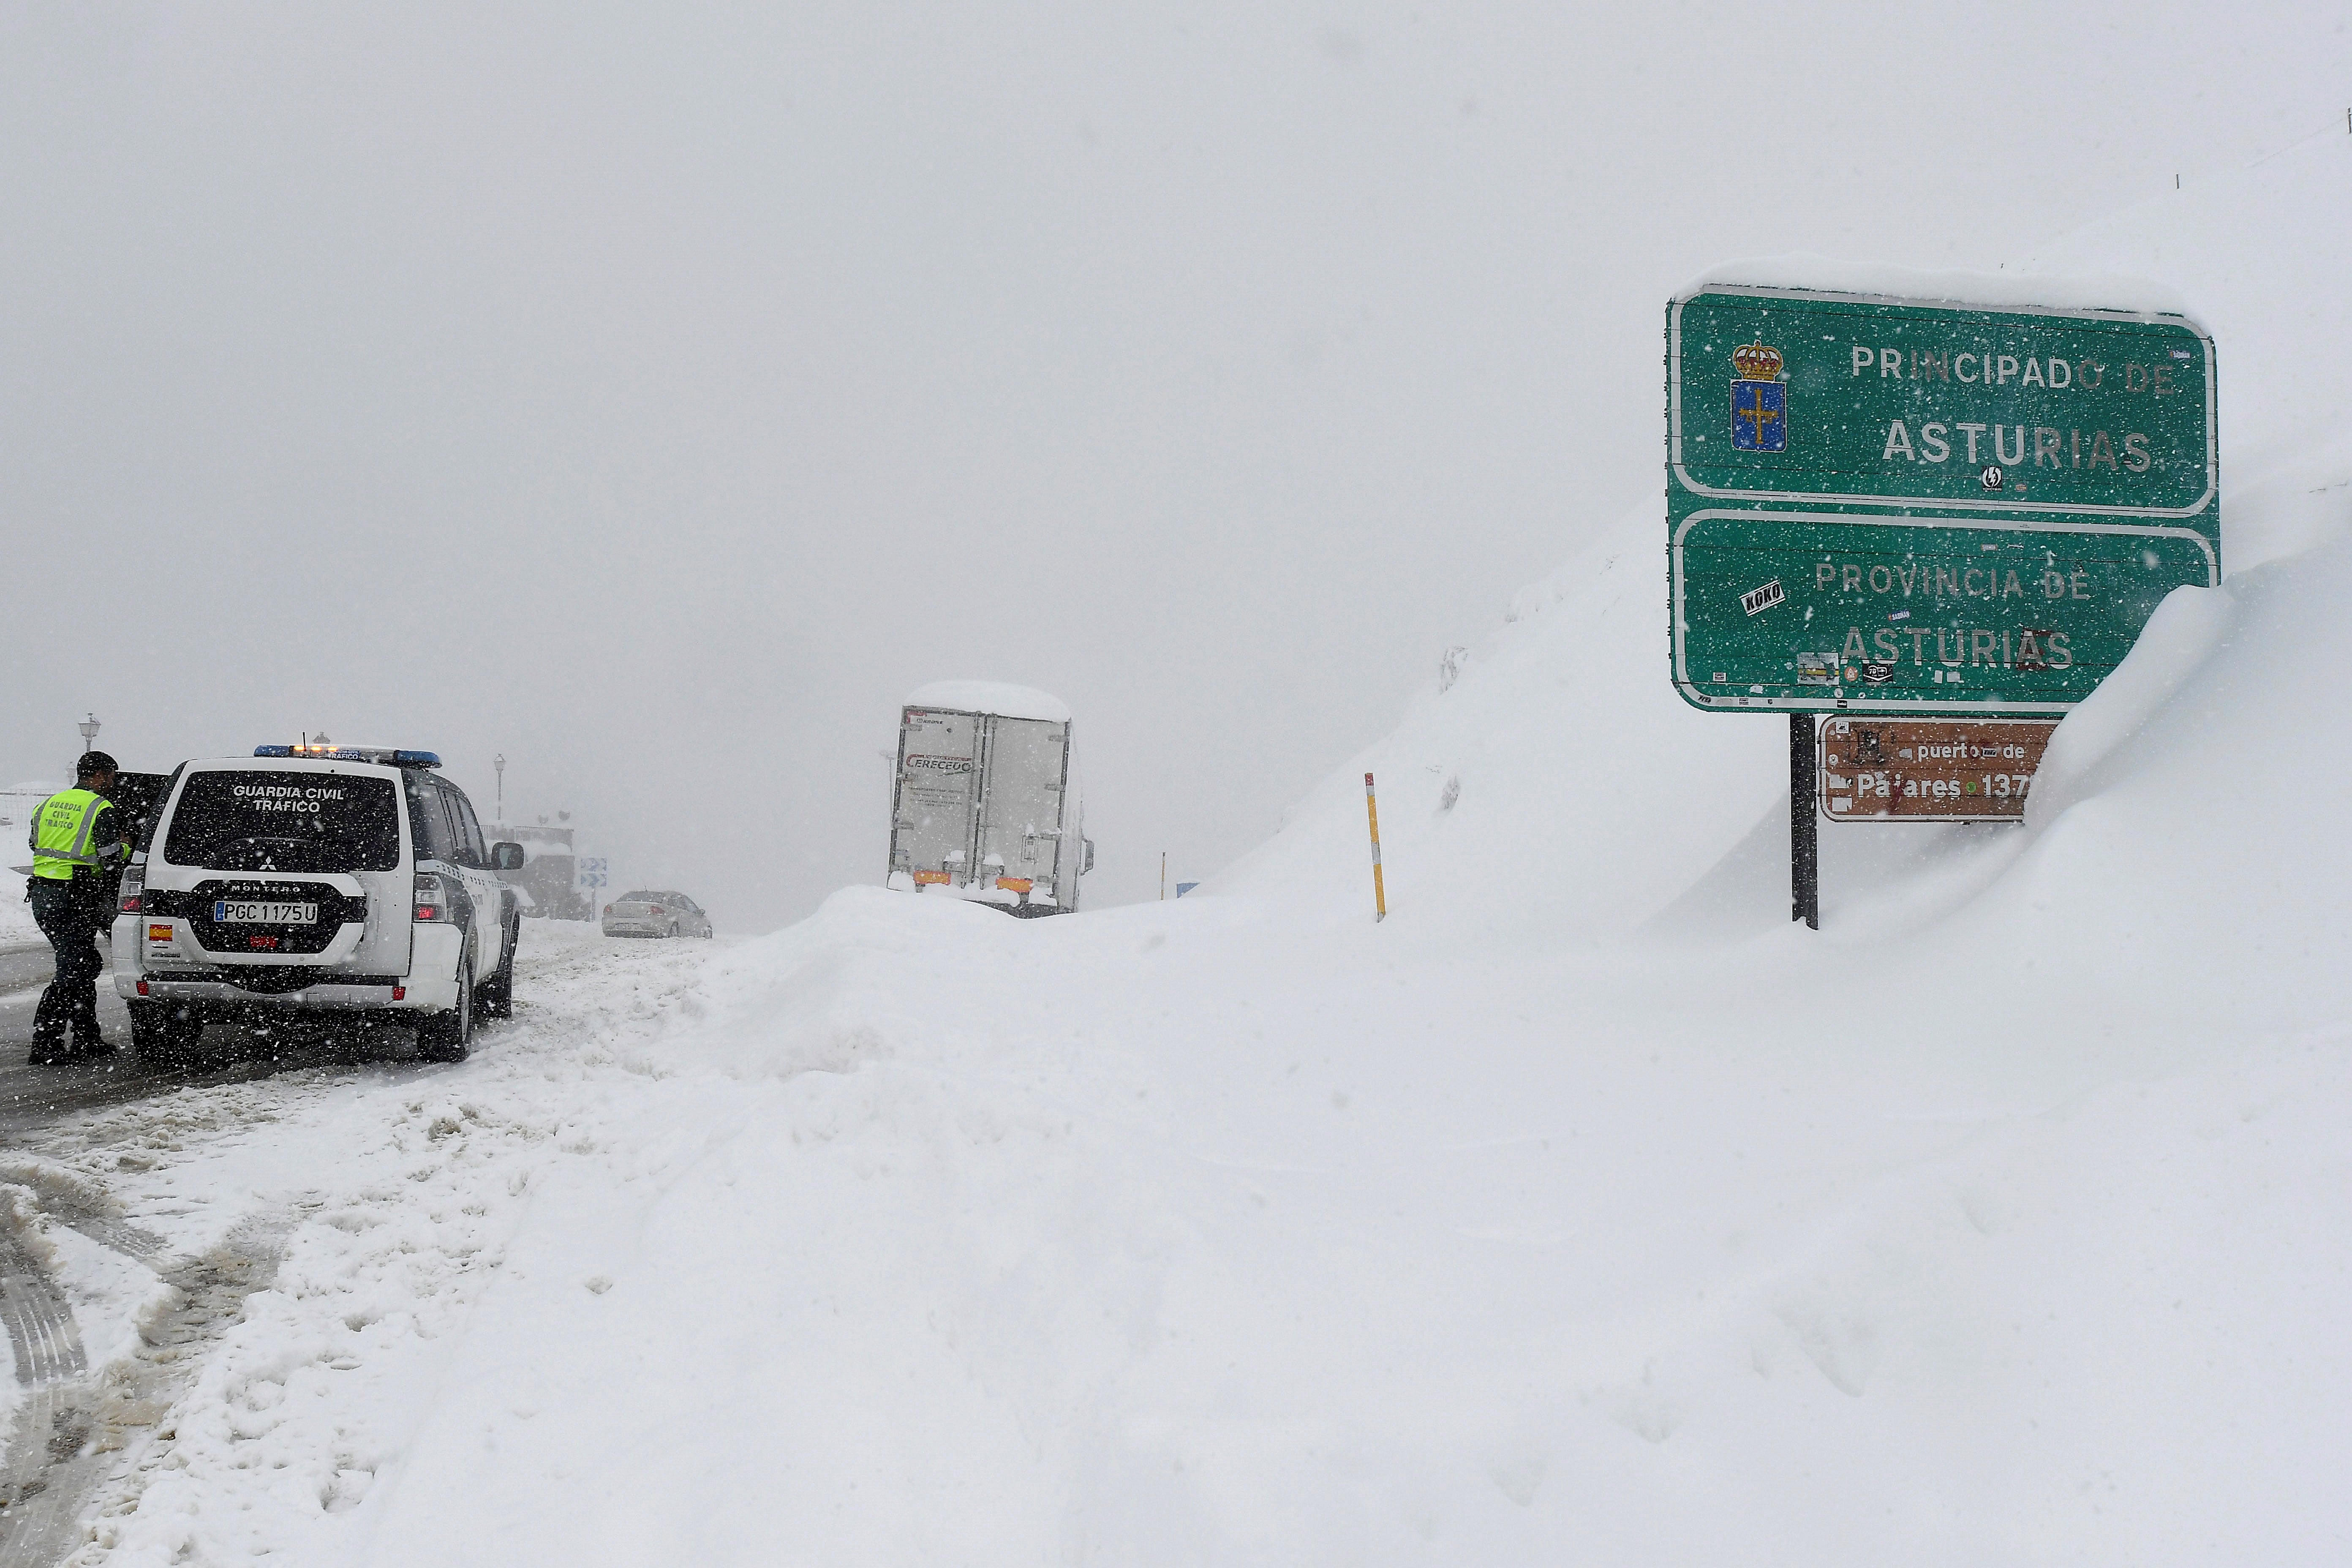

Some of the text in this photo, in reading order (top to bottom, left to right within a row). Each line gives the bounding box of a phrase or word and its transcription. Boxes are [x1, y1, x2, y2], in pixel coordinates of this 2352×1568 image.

[1852, 346, 2175, 395] PRINCIPADO DE
[1882, 419, 2151, 473] ASTURIAS
[1816, 563, 2090, 599] PROVINCIA DE
[1746, 584, 1780, 611] KOKO
[1840, 626, 2073, 670] ASTURIAS
[1918, 742, 2025, 762] puerto de
[233, 785, 344, 800] GUARDIA CIVIL
[49, 801, 82, 812] GUARDIA
[52, 810, 70, 819] CIVIL
